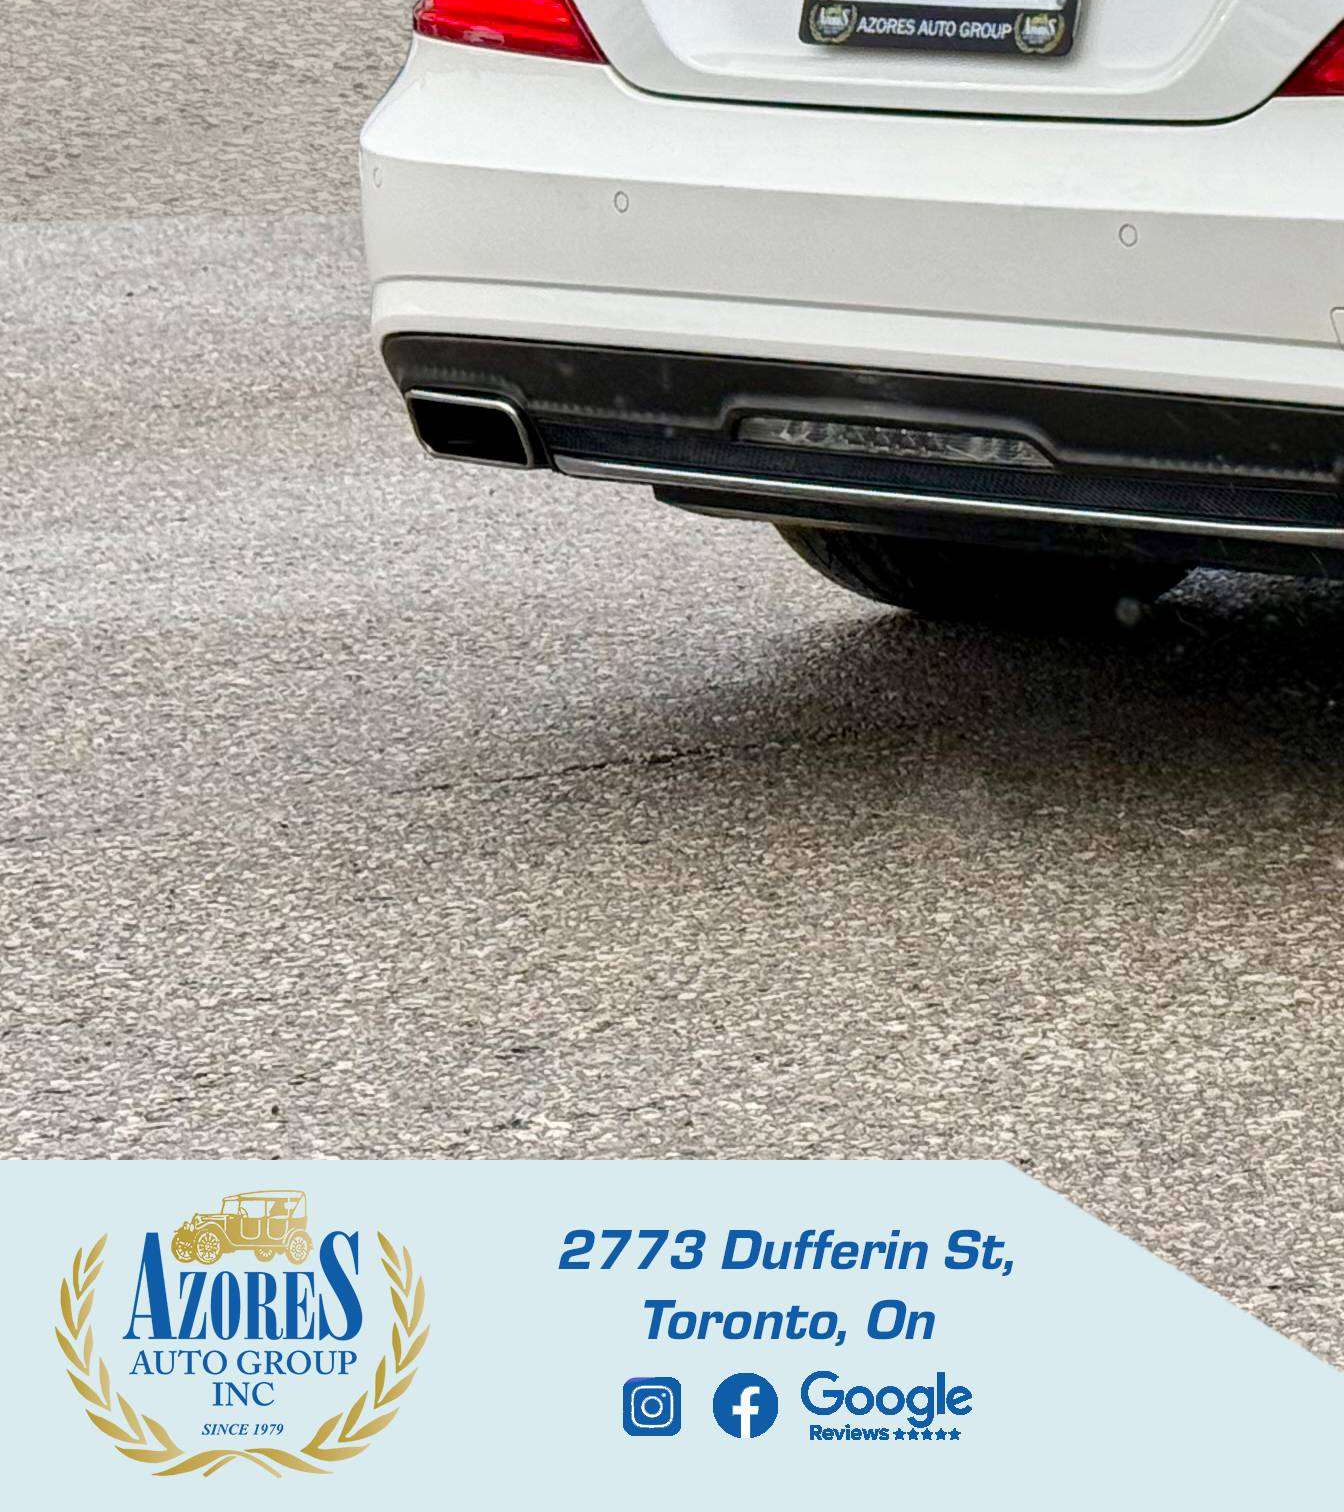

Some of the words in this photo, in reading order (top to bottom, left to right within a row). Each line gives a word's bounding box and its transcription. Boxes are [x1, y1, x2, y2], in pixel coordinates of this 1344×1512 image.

[856, 15, 916, 36] AZORES
[917, 18, 957, 37] AUTO
[959, 21, 1013, 39] GROUP
